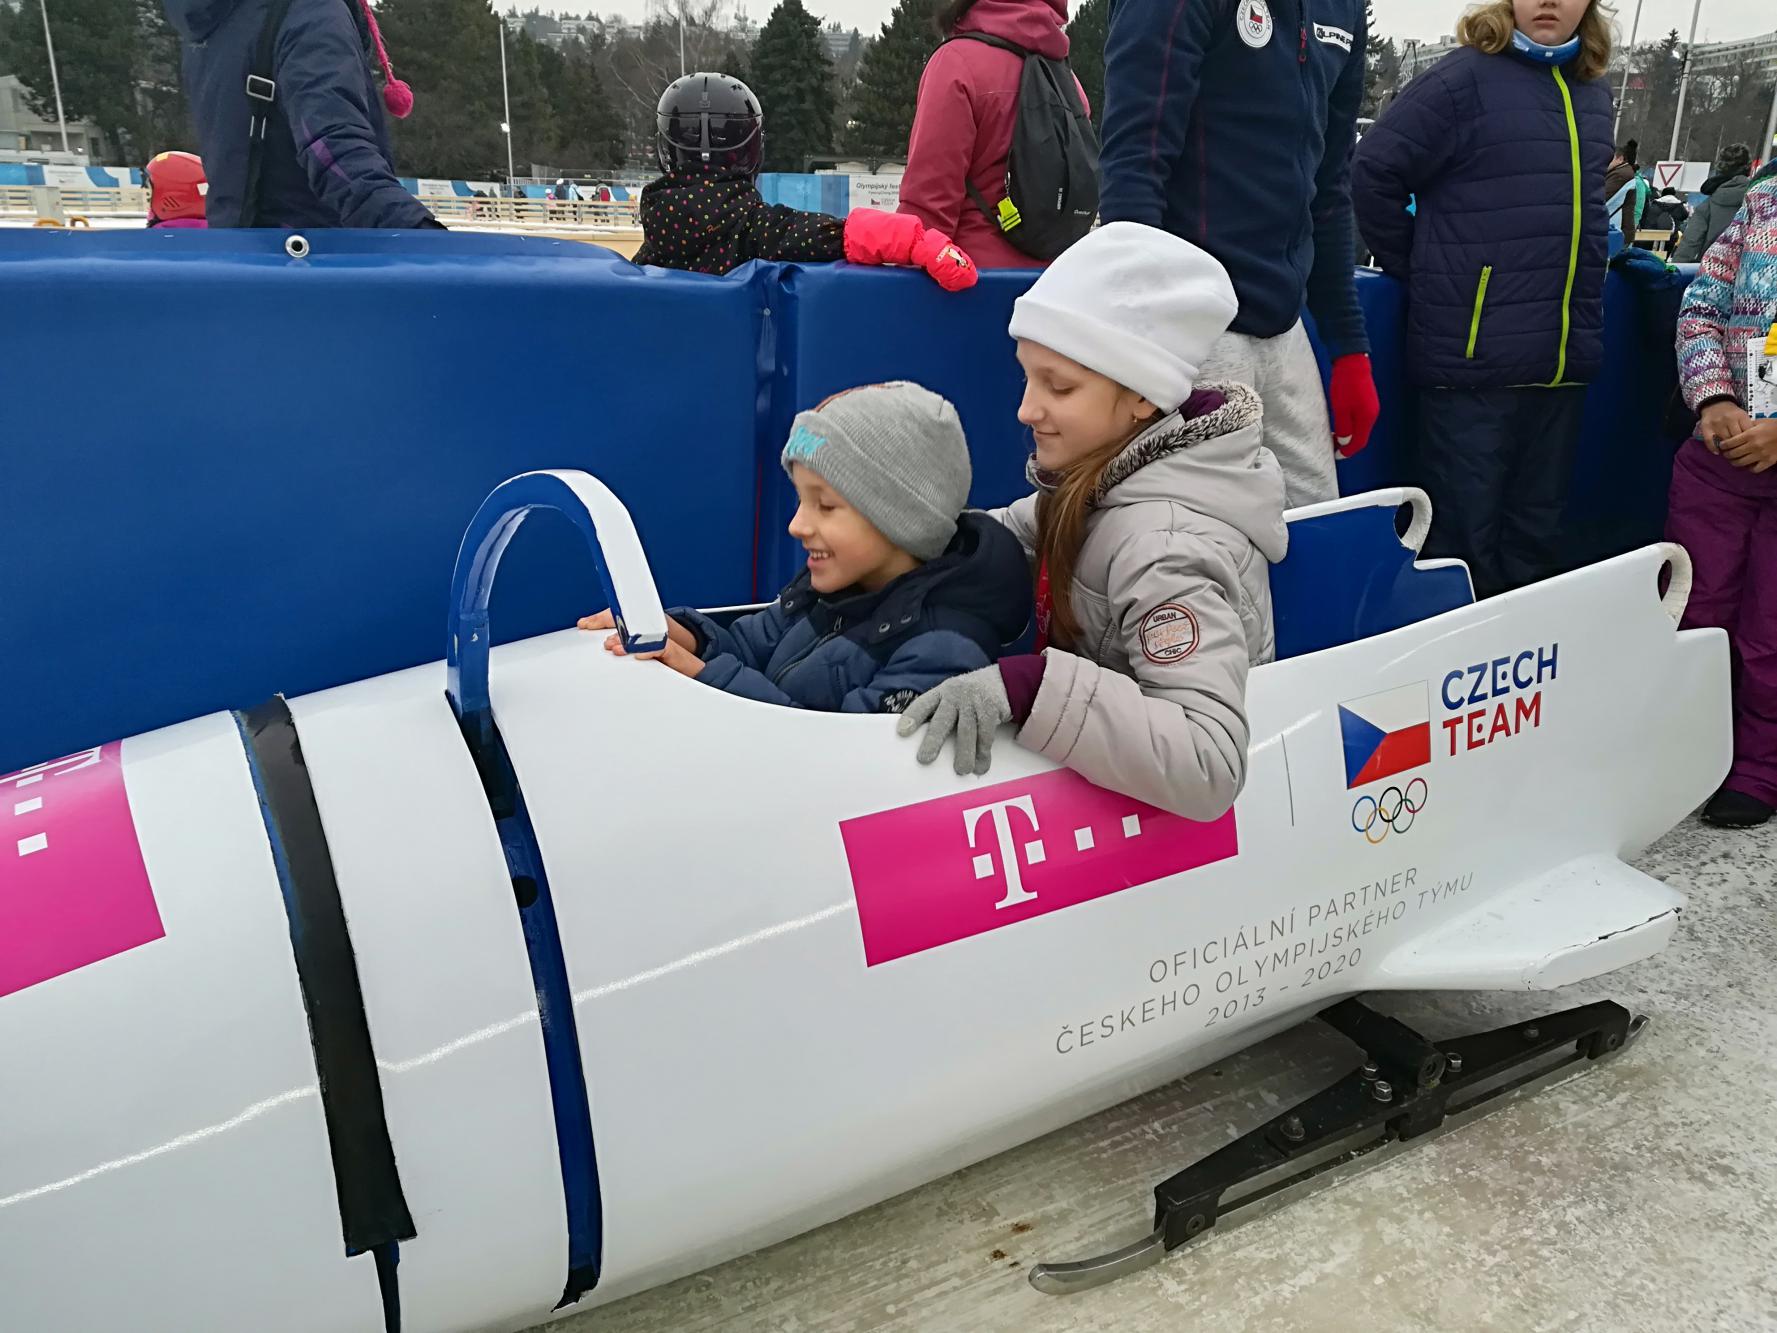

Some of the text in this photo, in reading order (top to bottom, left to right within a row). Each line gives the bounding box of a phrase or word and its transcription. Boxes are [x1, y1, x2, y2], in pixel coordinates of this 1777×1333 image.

[1153, 612, 1177, 622] URBAN
[1164, 648, 1182, 656] CHIC
[1442, 643, 1558, 710] CZECH
[1443, 691, 1541, 756] TEAM
[1150, 867, 1417, 984] OFICIÁLNÍ PARTNER
[1055, 871, 1473, 1055] ČESKEHO OLYMPIJSKÉHO TÝMU
[1204, 986, 1267, 1028] 2013
[1300, 947, 1362, 988] 2020
